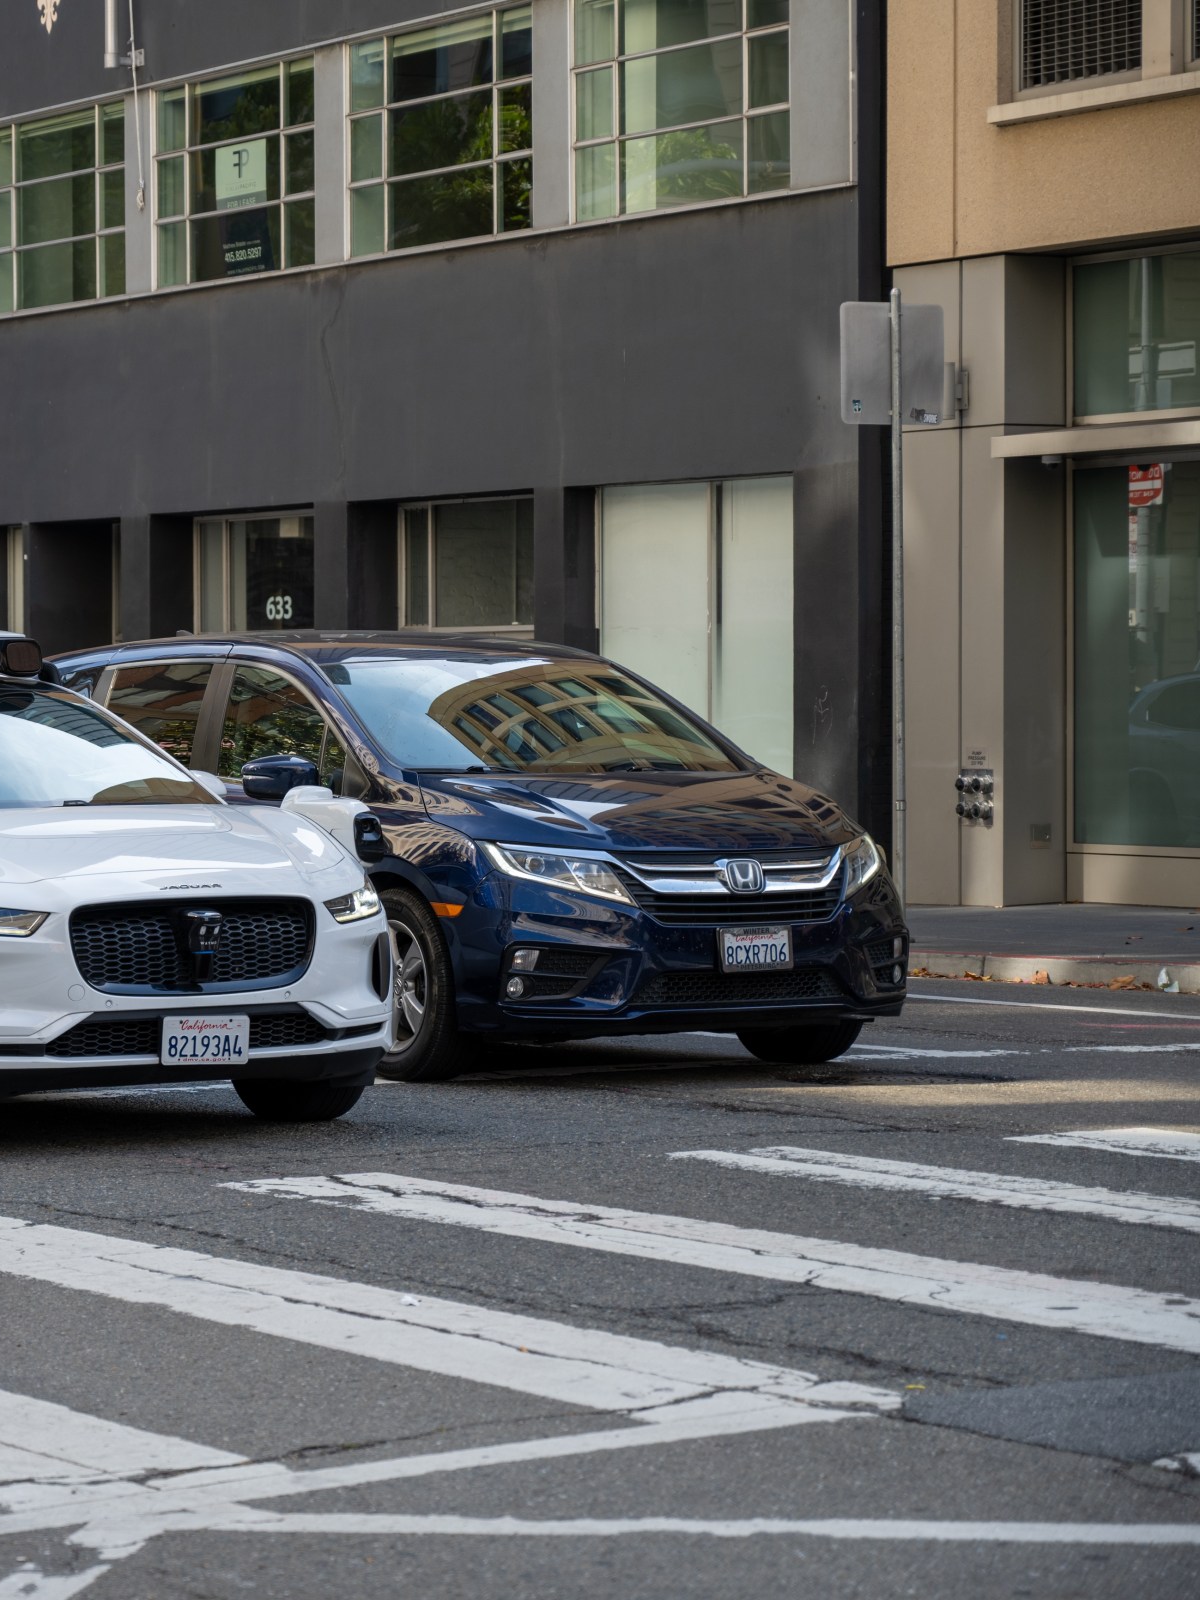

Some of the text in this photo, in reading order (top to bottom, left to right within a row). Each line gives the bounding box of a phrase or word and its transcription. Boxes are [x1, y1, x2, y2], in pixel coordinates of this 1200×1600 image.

[224, 246, 262, 262] 415.820.5297
[266, 595, 293, 620] 633
[160, 883, 222, 891] JAGUAR
[743, 927, 770, 935] WINTER
[726, 942, 787, 965] 8CXR706
[181, 1019, 233, 1033] California
[168, 1034, 242, 1058] 82193A4
